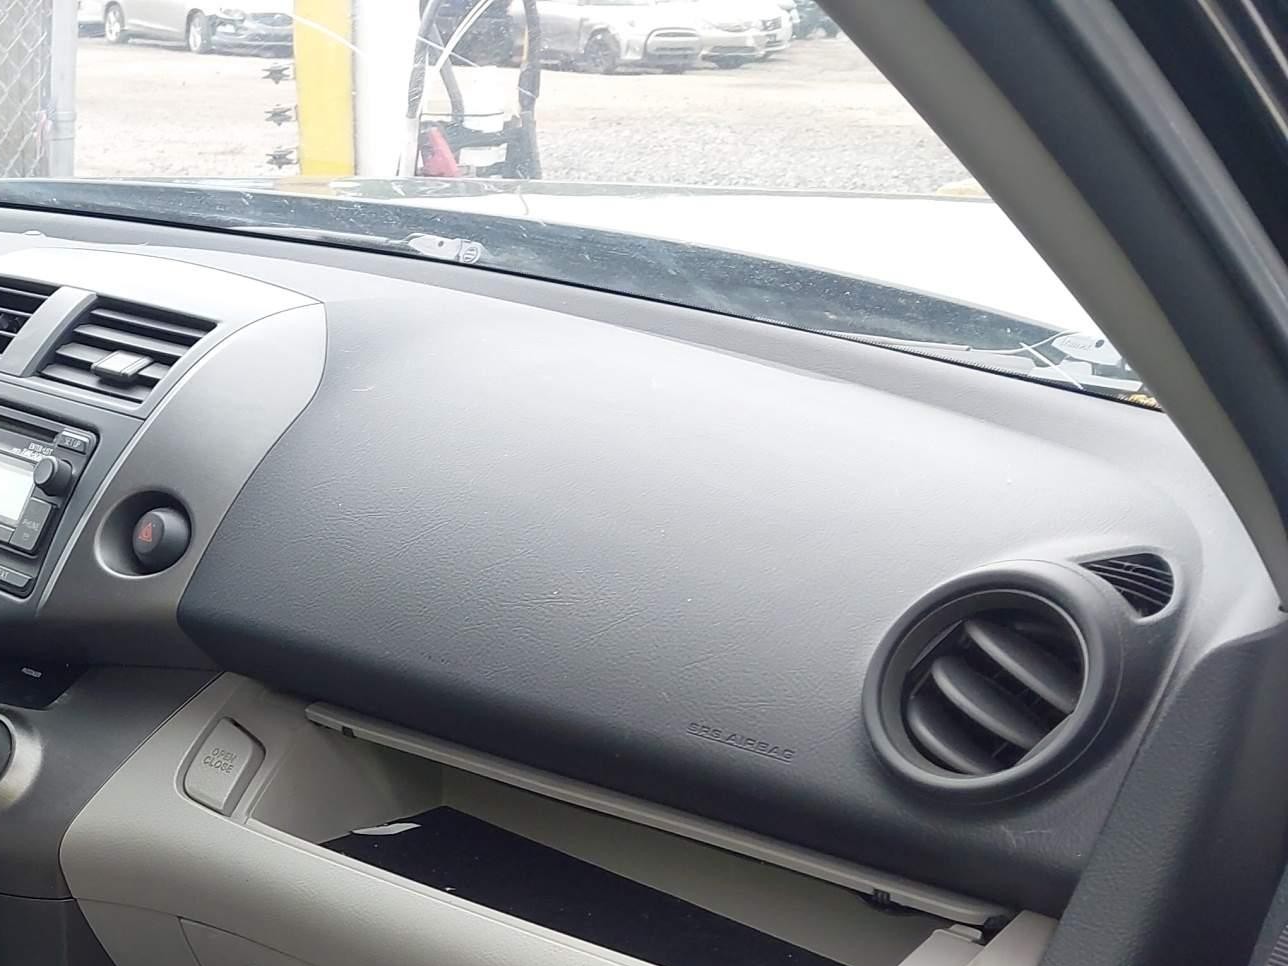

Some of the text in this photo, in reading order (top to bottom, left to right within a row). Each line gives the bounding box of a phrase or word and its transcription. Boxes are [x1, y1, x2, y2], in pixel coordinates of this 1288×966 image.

[211, 747, 237, 763] OPEN
[726, 733, 796, 760] AIRBAG
[203, 755, 234, 774] CLOSE
